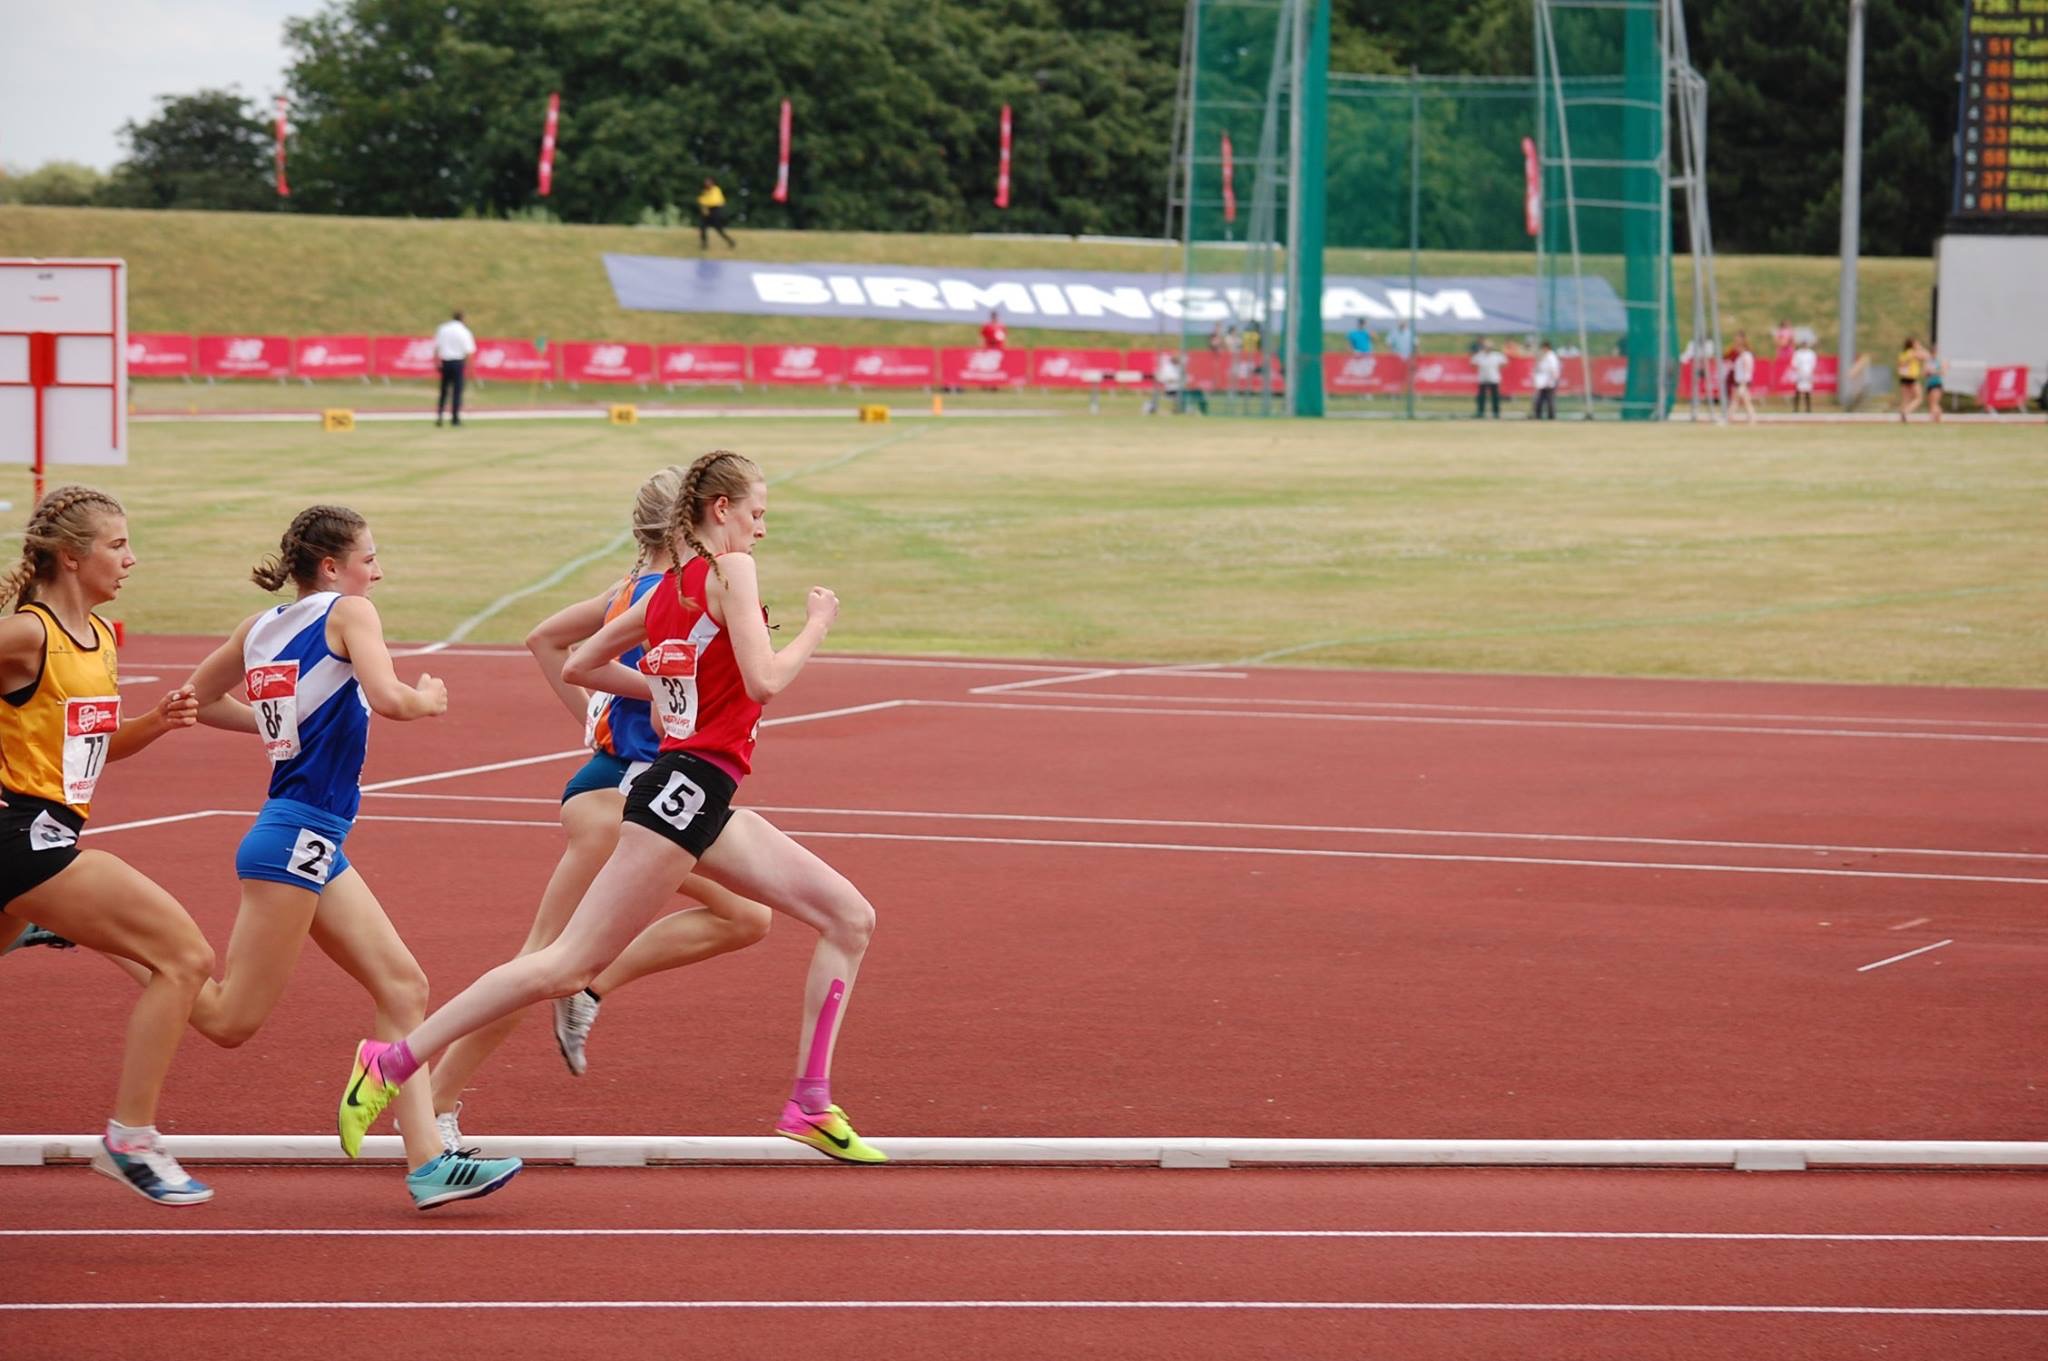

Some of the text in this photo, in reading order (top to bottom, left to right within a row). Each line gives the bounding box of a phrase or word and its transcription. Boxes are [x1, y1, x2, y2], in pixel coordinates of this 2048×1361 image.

[751, 272, 1484, 320] BIRMINGHAM
[661, 677, 687, 715] 33
[84, 735, 104, 778] 77
[661, 783, 696, 817] 5
[297, 839, 326, 877] 2
